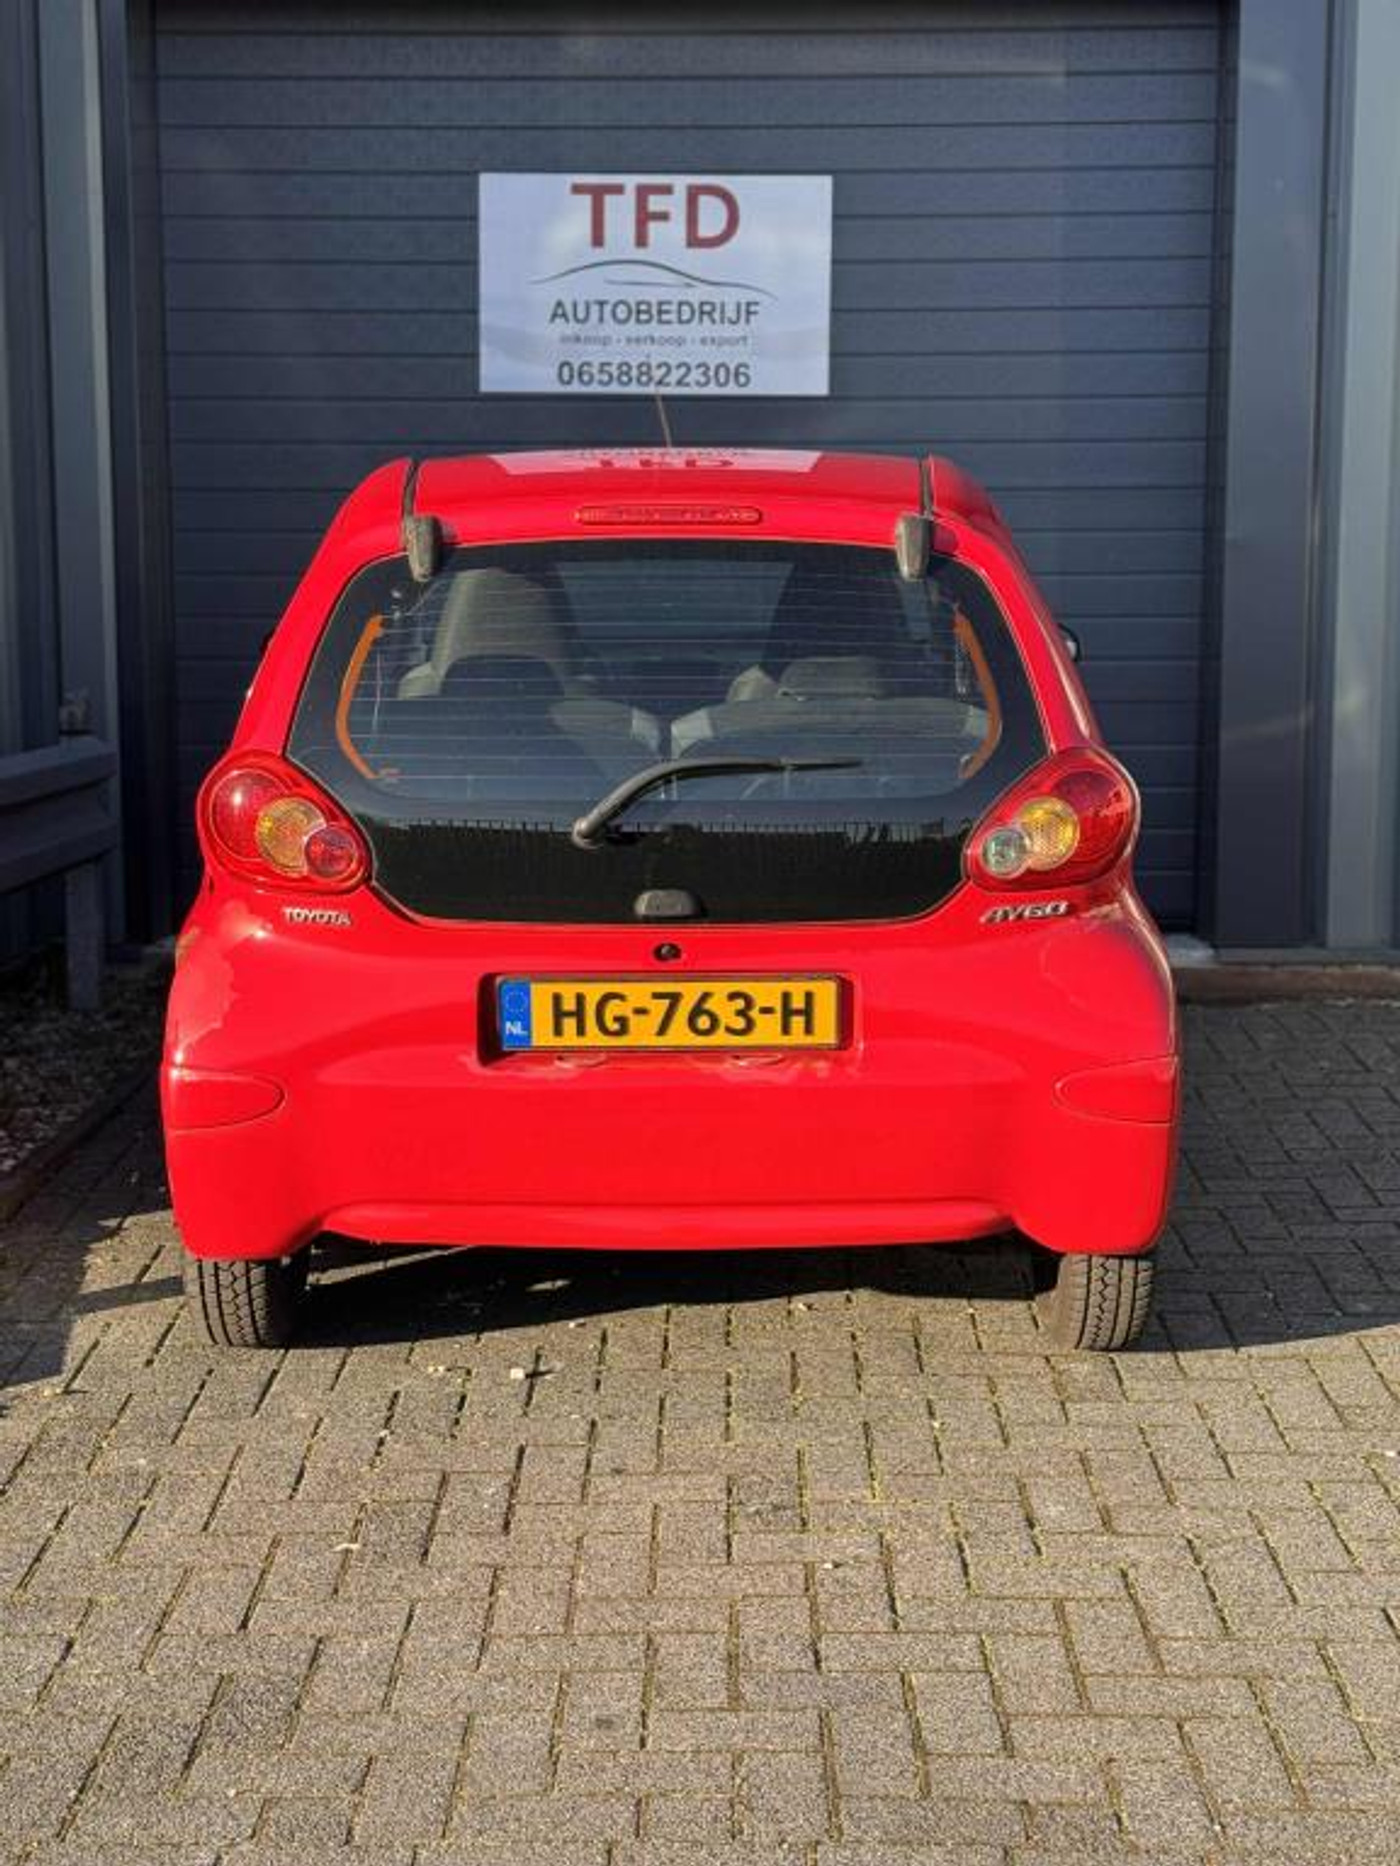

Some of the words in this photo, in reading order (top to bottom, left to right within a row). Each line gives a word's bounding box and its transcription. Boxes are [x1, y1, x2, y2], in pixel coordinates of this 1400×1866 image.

[570, 182, 741, 249] TFD
[549, 300, 760, 326] AUTOBEDRIJF
[557, 361, 752, 388] 0658822306
[282, 907, 353, 926] TOYOTA
[551, 990, 817, 1037] HG-763-H
[505, 1021, 529, 1035] NL
